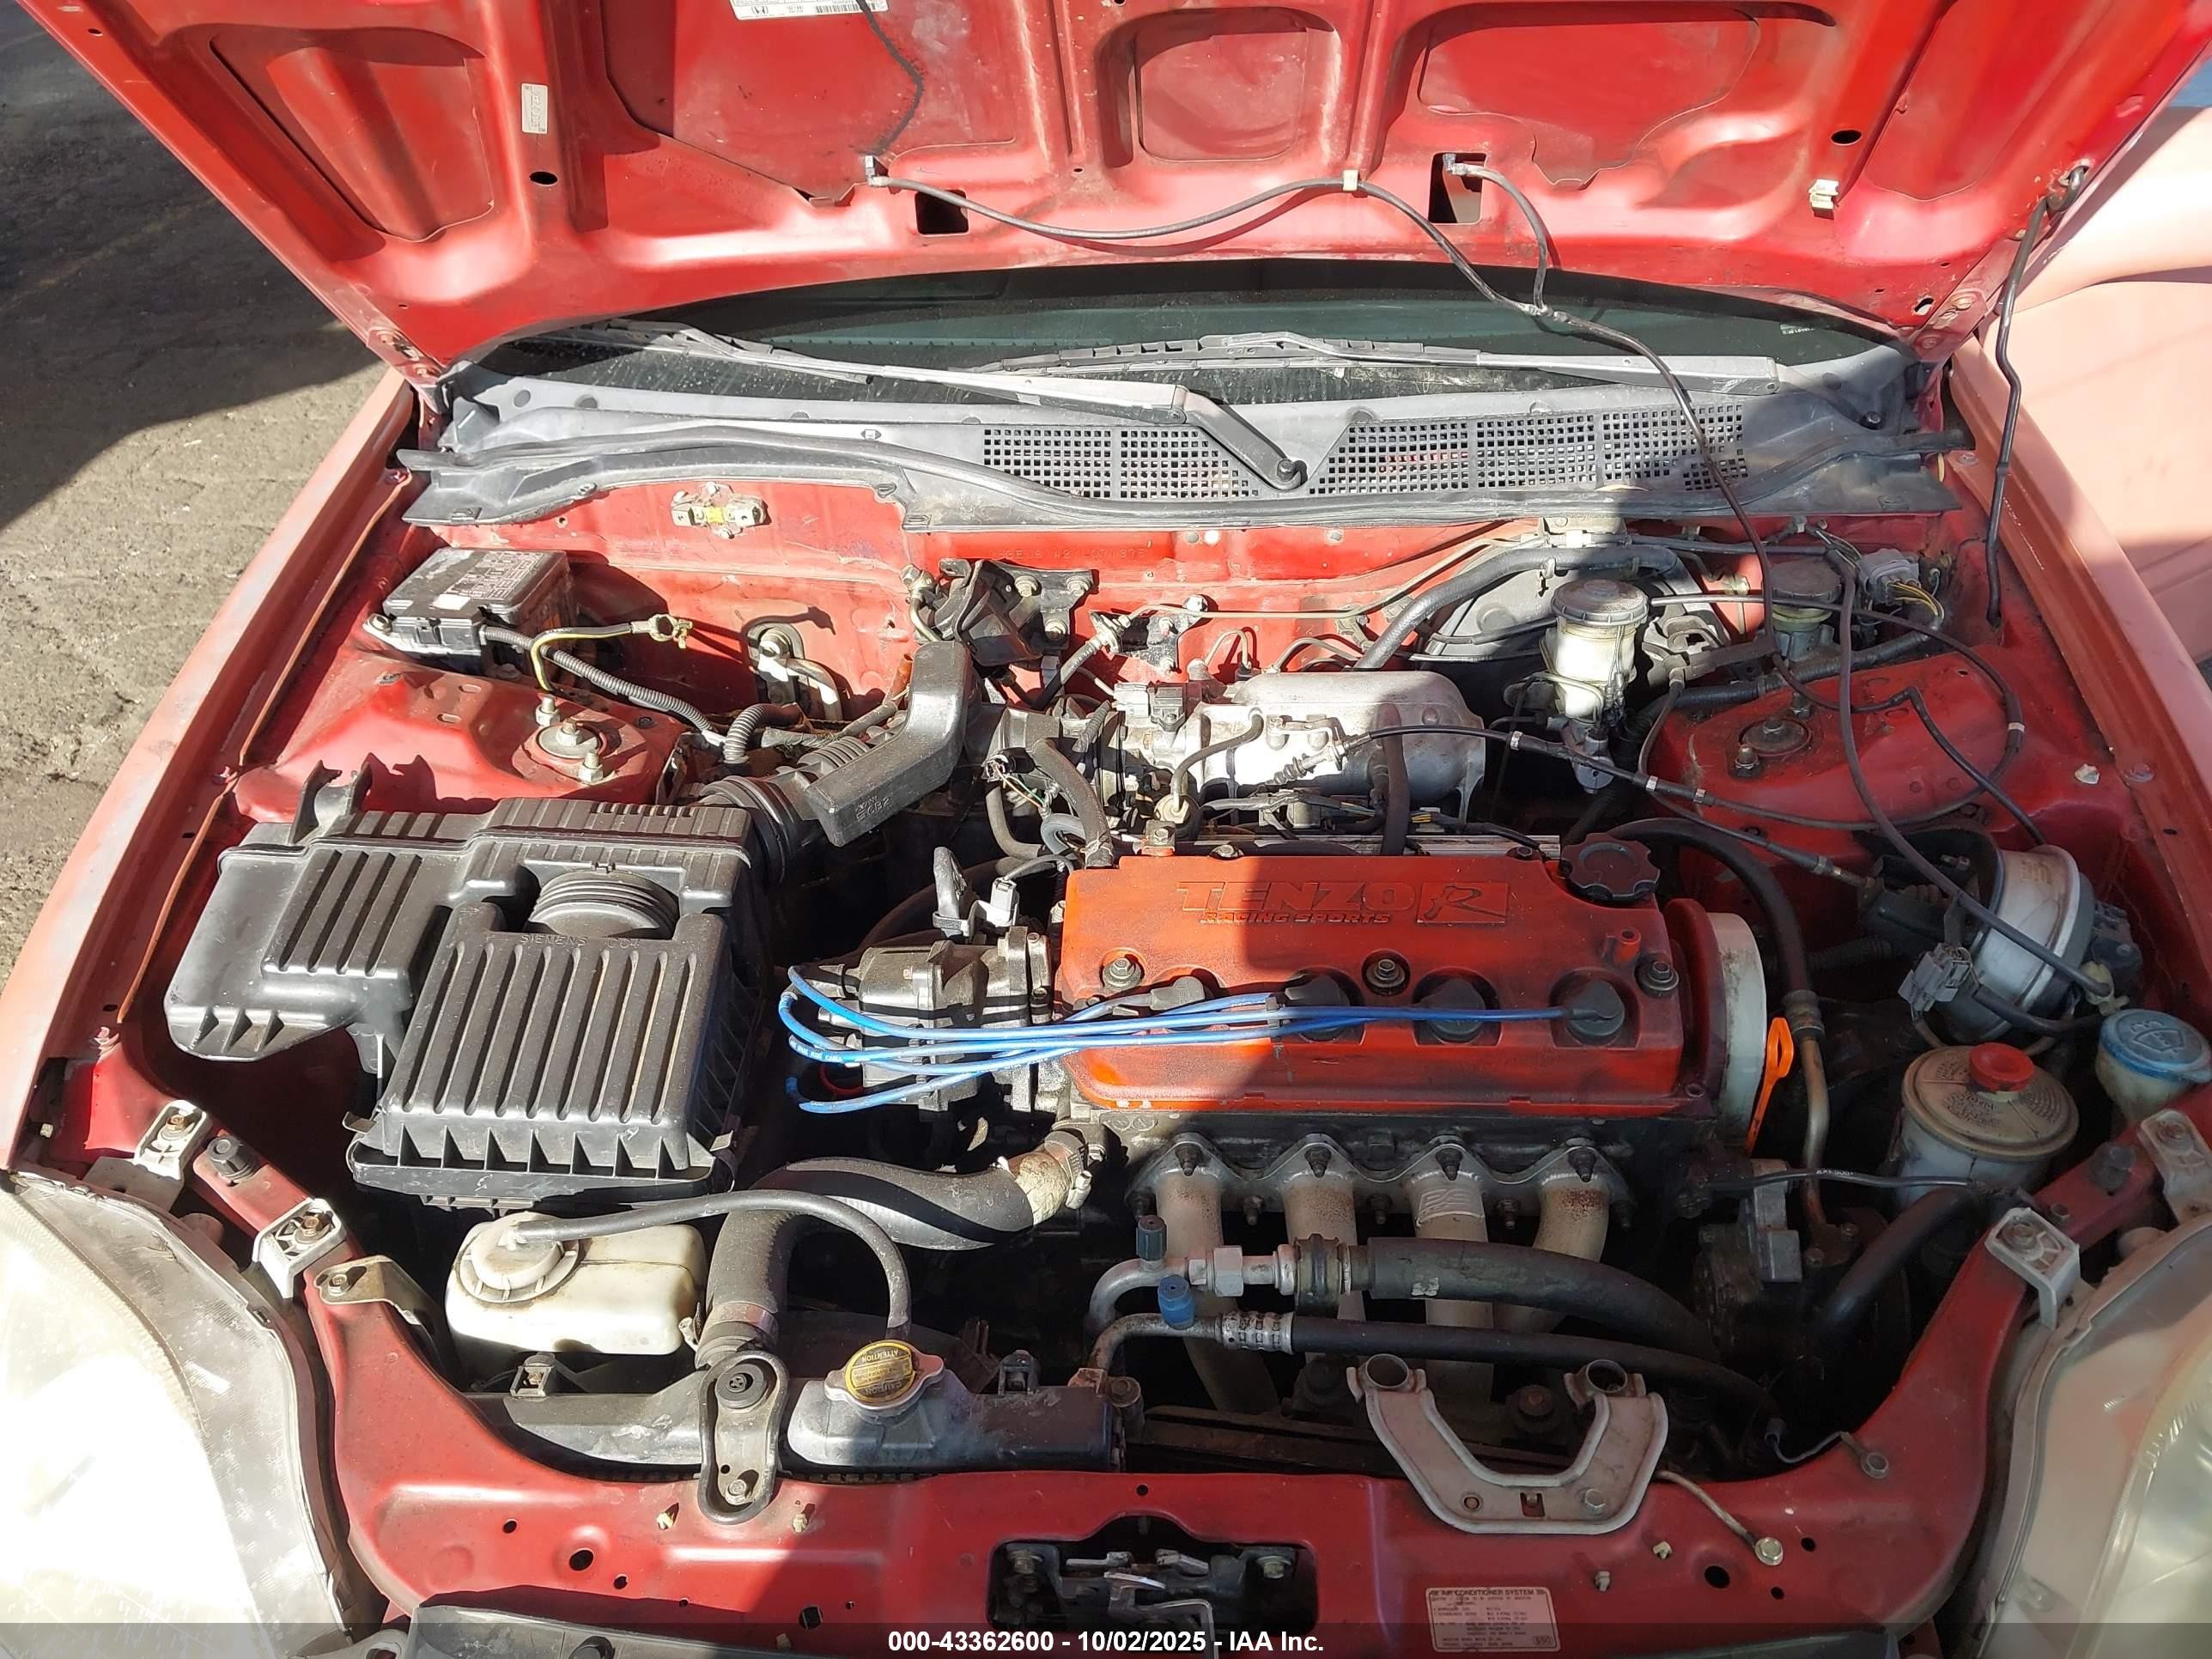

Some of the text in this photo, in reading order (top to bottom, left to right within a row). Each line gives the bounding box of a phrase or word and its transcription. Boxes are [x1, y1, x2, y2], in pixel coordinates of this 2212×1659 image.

[1176, 881, 1416, 911] TENZO
[1201, 912, 1390, 924] RACING SPORTS
[520, 933, 589, 947] SIEMENS
[861, 1349, 899, 1363] ATTENTION
[865, 1382, 902, 1395] CAUTION
